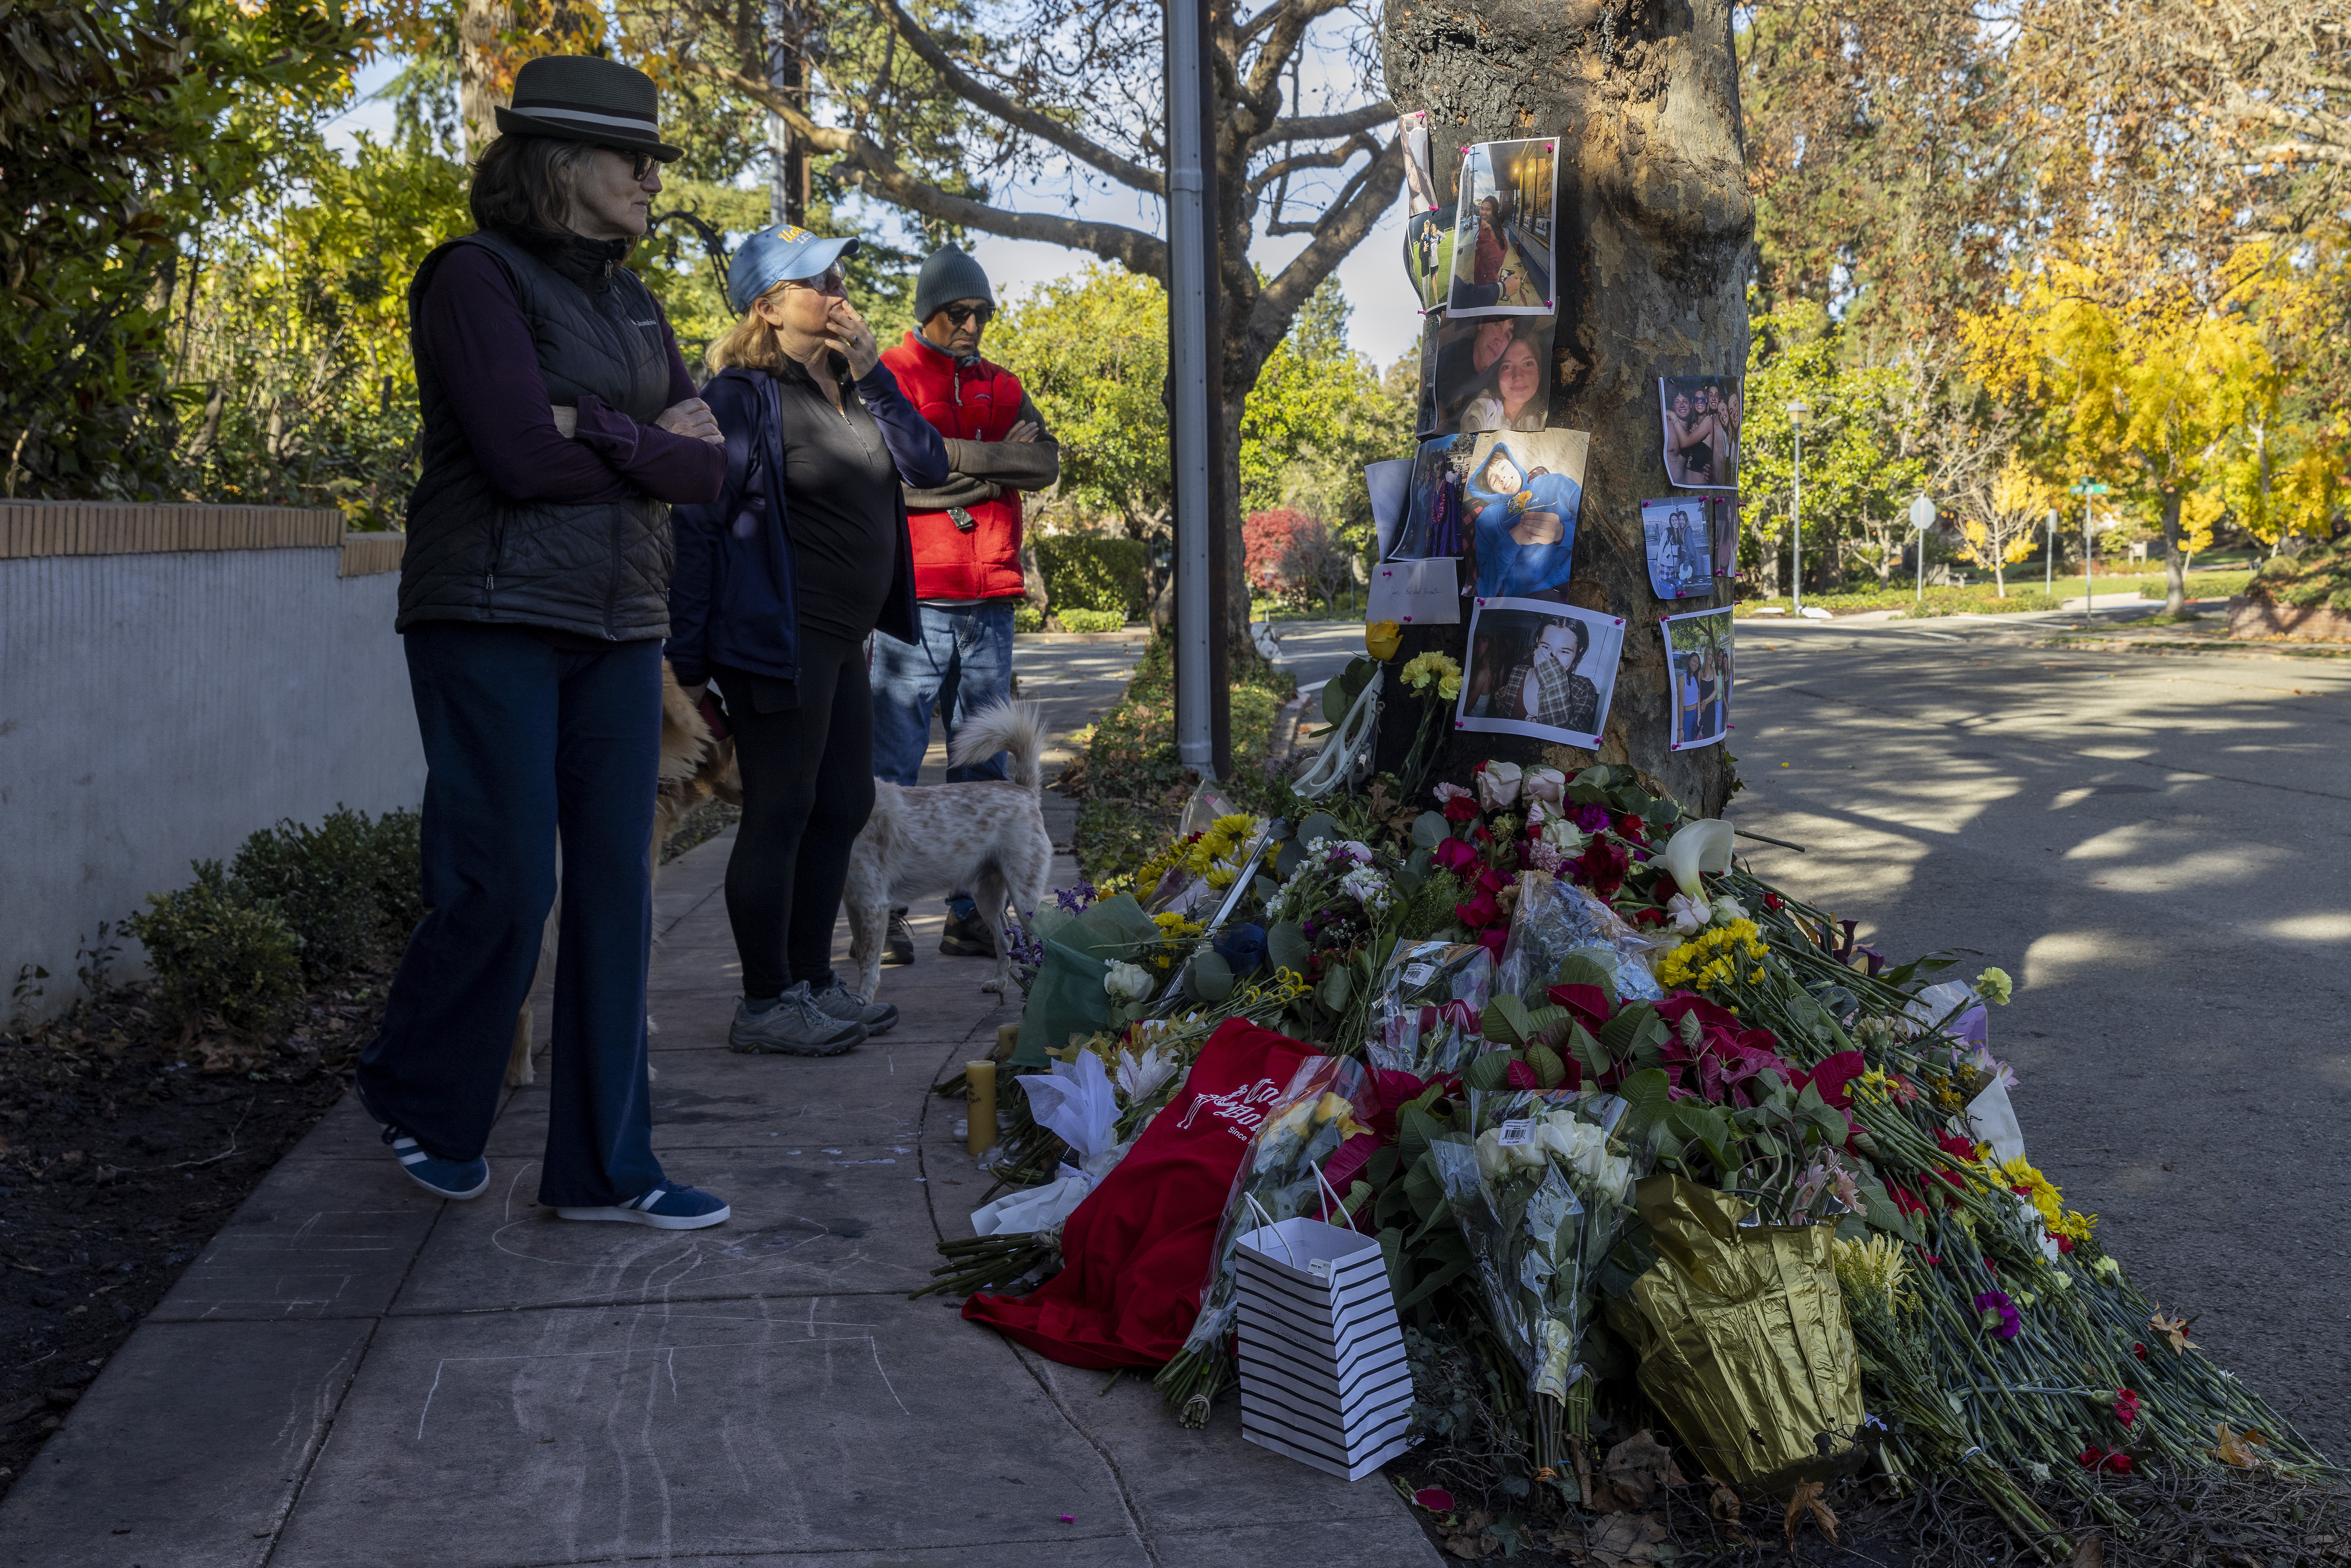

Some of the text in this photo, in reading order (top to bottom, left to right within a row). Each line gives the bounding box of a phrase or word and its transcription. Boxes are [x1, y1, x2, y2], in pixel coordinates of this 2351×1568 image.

[1389, 587, 1400, 598] Dear
[1228, 1126, 1247, 1141] Since
[1266, 1304, 1282, 1319] Soren
[1299, 1338, 1311, 1348] Emma
